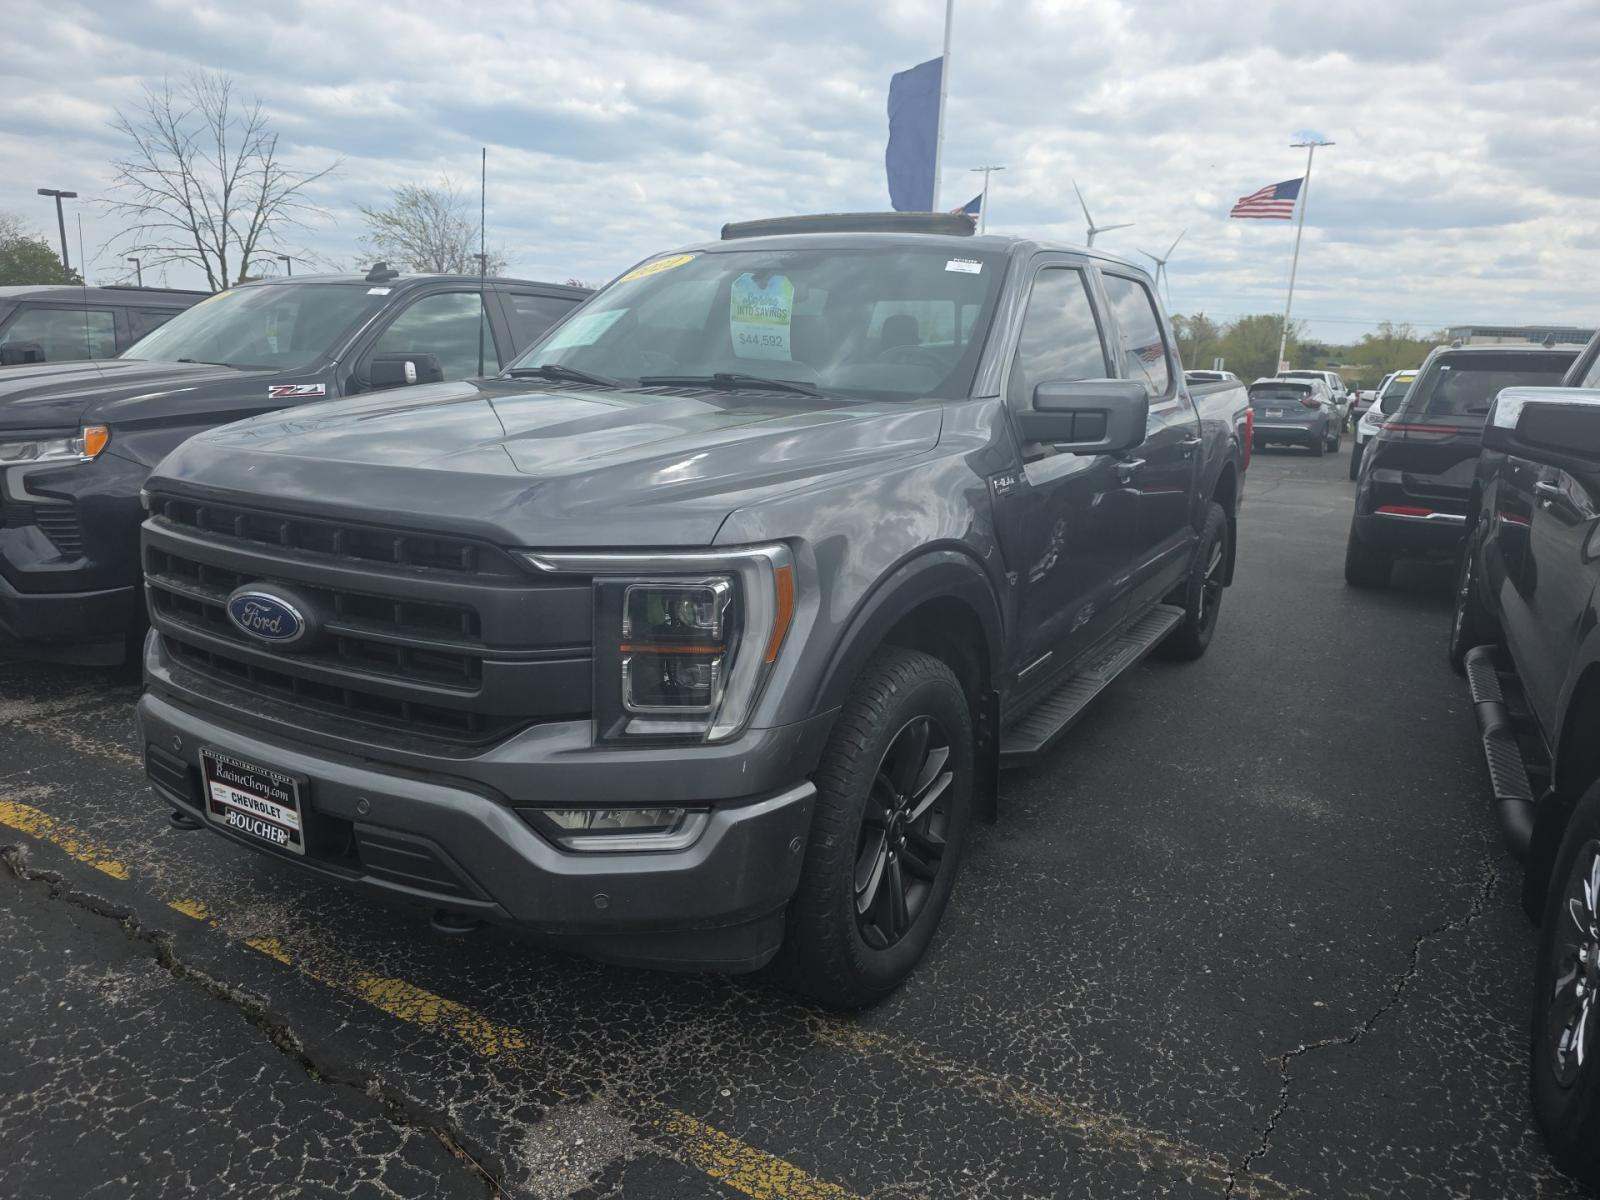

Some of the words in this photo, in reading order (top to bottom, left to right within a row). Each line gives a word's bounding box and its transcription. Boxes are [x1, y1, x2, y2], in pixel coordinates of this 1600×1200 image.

[737, 304, 752, 316] INTO
[755, 306, 787, 321] SAVINGS
[739, 333, 783, 348] $44,592
[241, 601, 283, 634] Ford
[231, 791, 281, 819] CHEVROLET
[229, 810, 285, 844] BOUCHER
